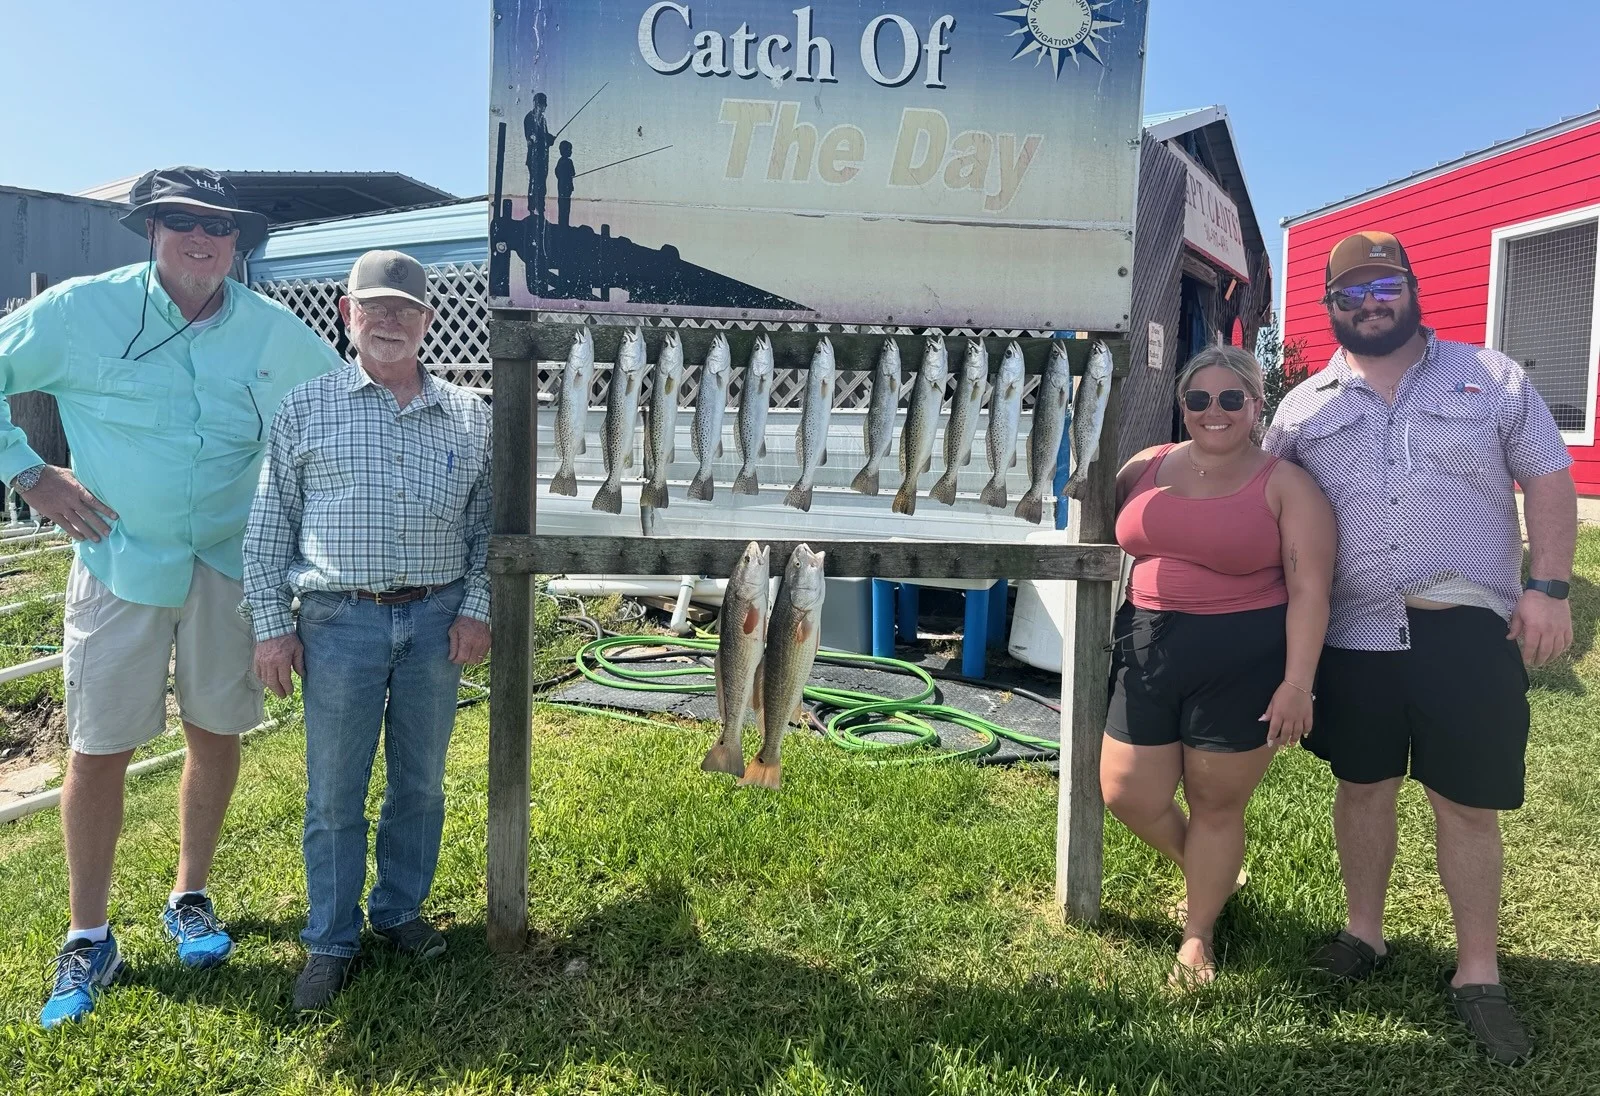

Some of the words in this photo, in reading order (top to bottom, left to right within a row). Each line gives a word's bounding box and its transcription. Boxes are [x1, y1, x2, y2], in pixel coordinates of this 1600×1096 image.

[638, 1, 838, 84] Catch
[860, 14, 956, 89] Of
[1030, 17, 1075, 46] NAVIGATION
[1074, 20, 1090, 40] DIST.
[718, 98, 867, 186] The
[887, 107, 1044, 212] Day
[196, 178, 225, 194] Huk
